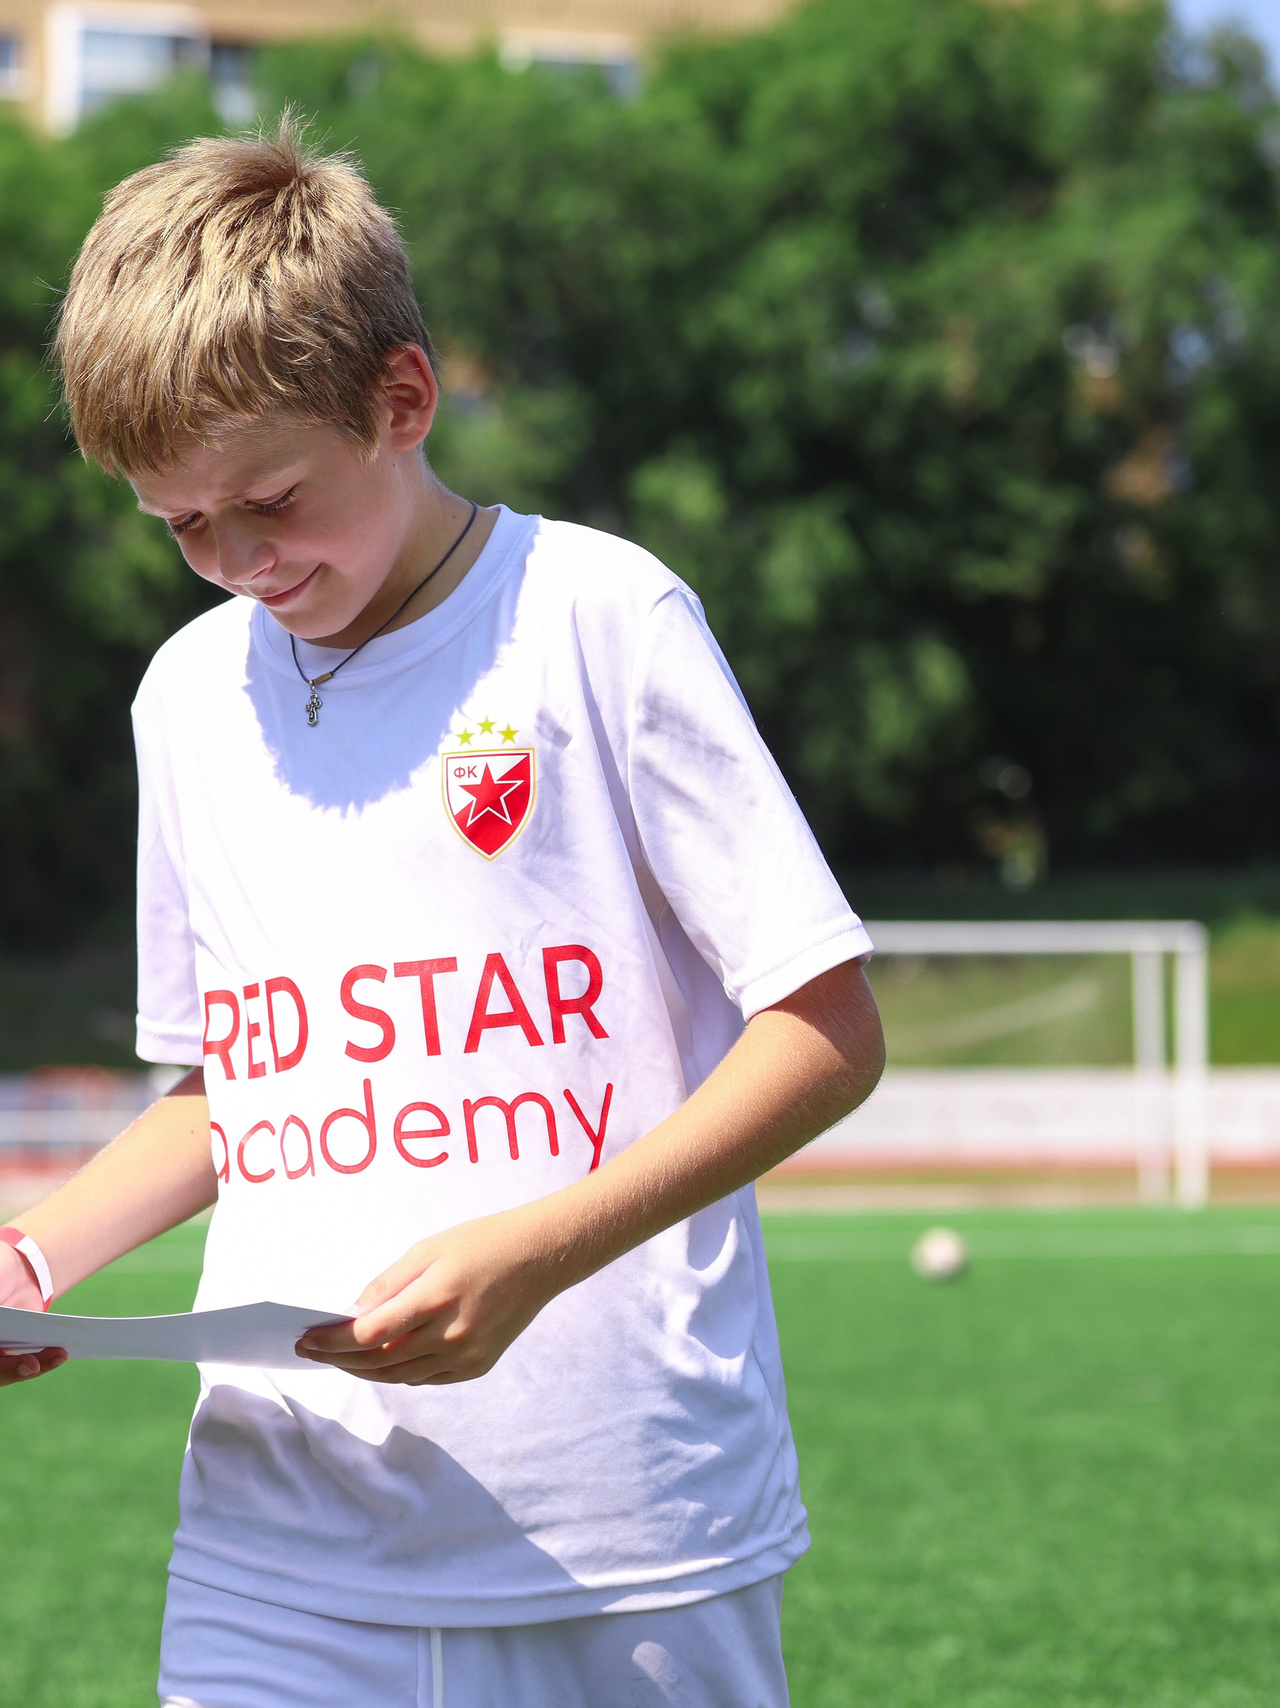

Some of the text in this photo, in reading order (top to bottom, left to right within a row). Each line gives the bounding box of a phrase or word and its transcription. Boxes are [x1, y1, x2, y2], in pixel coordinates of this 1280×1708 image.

[453, 765, 478, 779] ФК
[203, 943, 610, 1080] RED STAR
